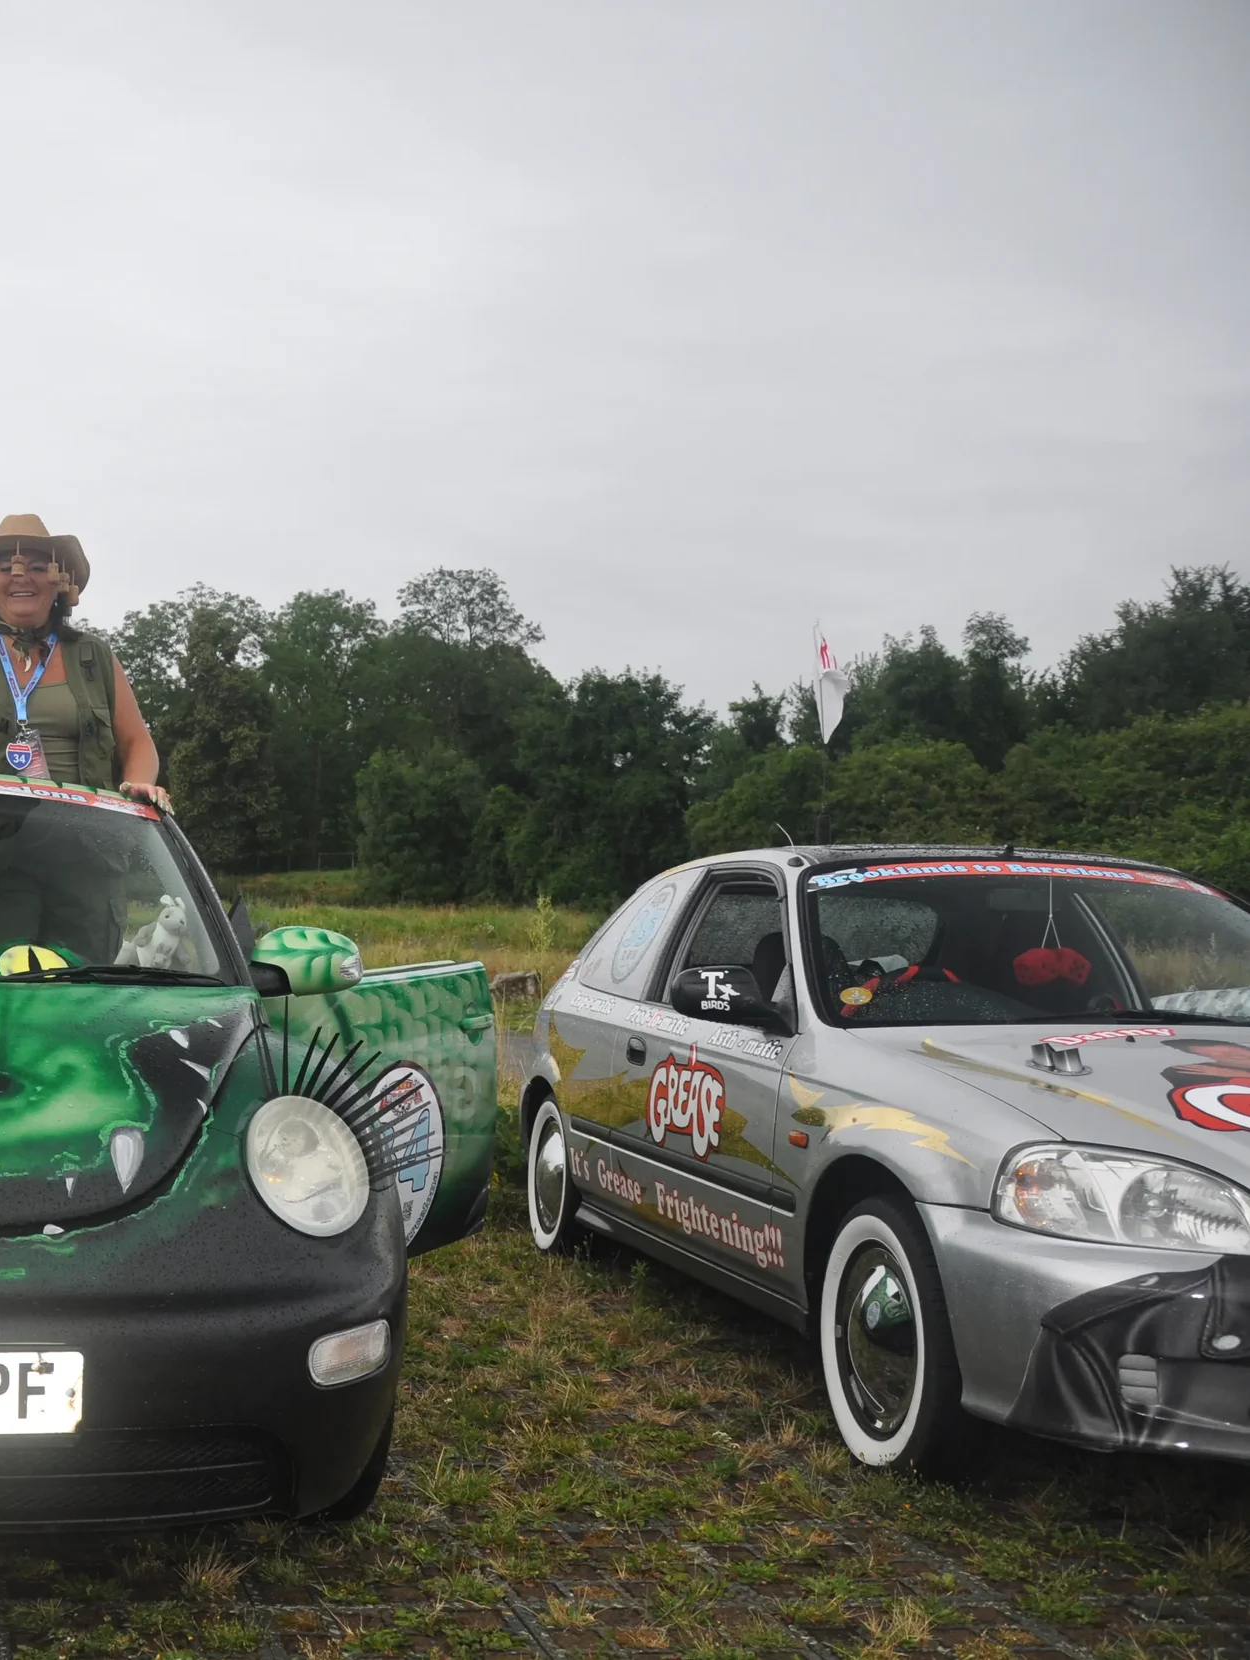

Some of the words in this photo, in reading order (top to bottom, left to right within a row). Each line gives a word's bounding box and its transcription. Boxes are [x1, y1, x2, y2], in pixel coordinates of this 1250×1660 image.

[13, 753, 26, 764] 34
[815, 864, 969, 887] Brooklands
[973, 864, 1002, 873] to
[1006, 863, 1135, 881] Barcelona
[700, 1000, 731, 1011] BIRDS
[1040, 1027, 1177, 1046] Danny
[650, 1064, 723, 1158] GREASE
[570, 1146, 591, 1182] It's
[597, 1158, 643, 1205] Grease
